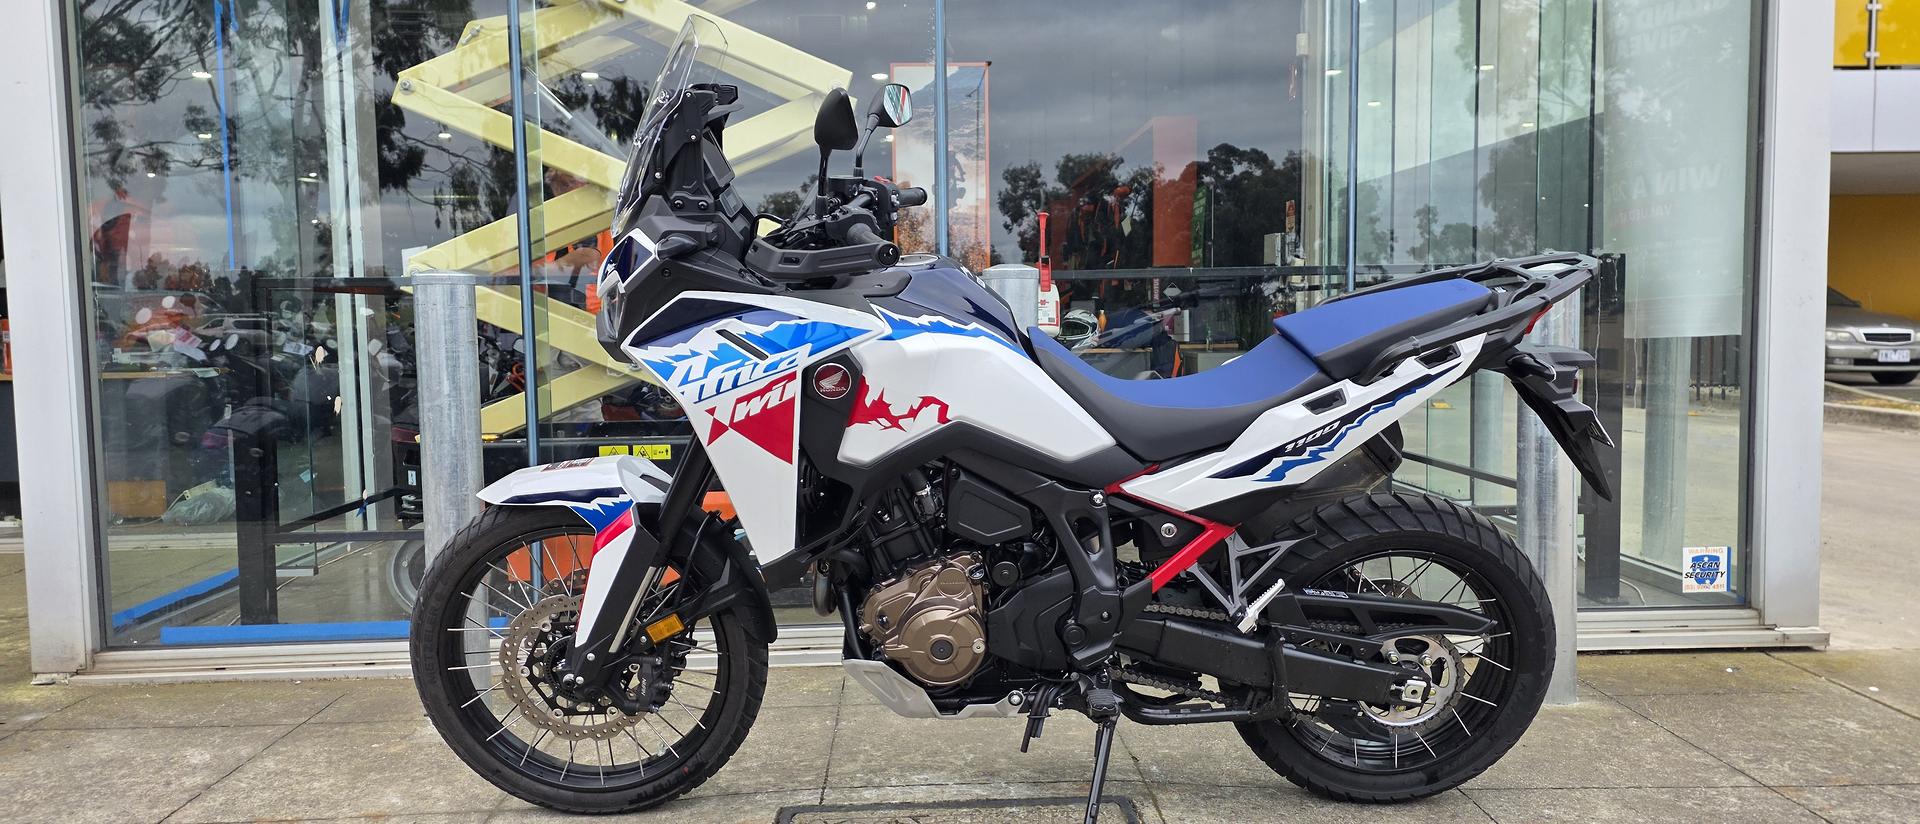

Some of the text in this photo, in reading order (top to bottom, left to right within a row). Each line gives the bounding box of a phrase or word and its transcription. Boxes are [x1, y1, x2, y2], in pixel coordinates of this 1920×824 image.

[666, 350, 800, 403] Africa
[1285, 420, 1341, 453] 1100
[1684, 571, 1726, 579] SECURITY
[1690, 561, 1721, 569] ASCAN
